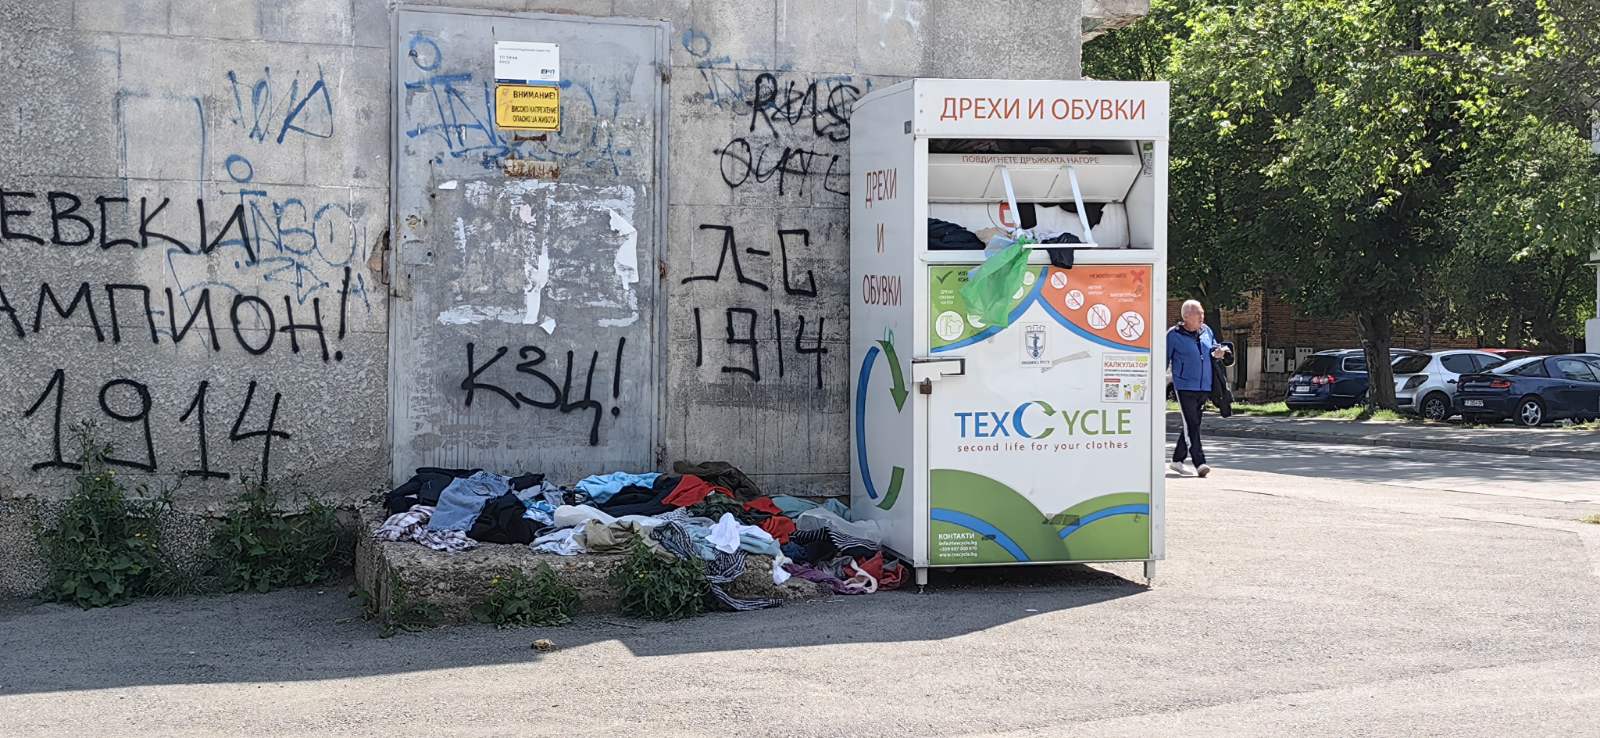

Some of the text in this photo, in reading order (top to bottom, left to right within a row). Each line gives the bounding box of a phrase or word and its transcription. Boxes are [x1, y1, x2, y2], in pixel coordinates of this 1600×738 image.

[513, 90, 556, 99] ВНИМАНИЕ!
[940, 97, 1146, 122] ДРЕХИ И ОБУВКИ
[962, 155, 1099, 165] ПОВДИГНЕТЕ ДРЪЖКАТА НАГОРЕ
[865, 167, 897, 208] ДРЕХИ
[876, 223, 885, 253] И
[862, 274, 902, 306] ОБУВКИ
[694, 307, 828, 390] 1914
[1104, 361, 1148, 369] КАЛКУЛАТОР
[24, 368, 290, 482] 1914
[957, 439, 1129, 453] second life for your clothes
